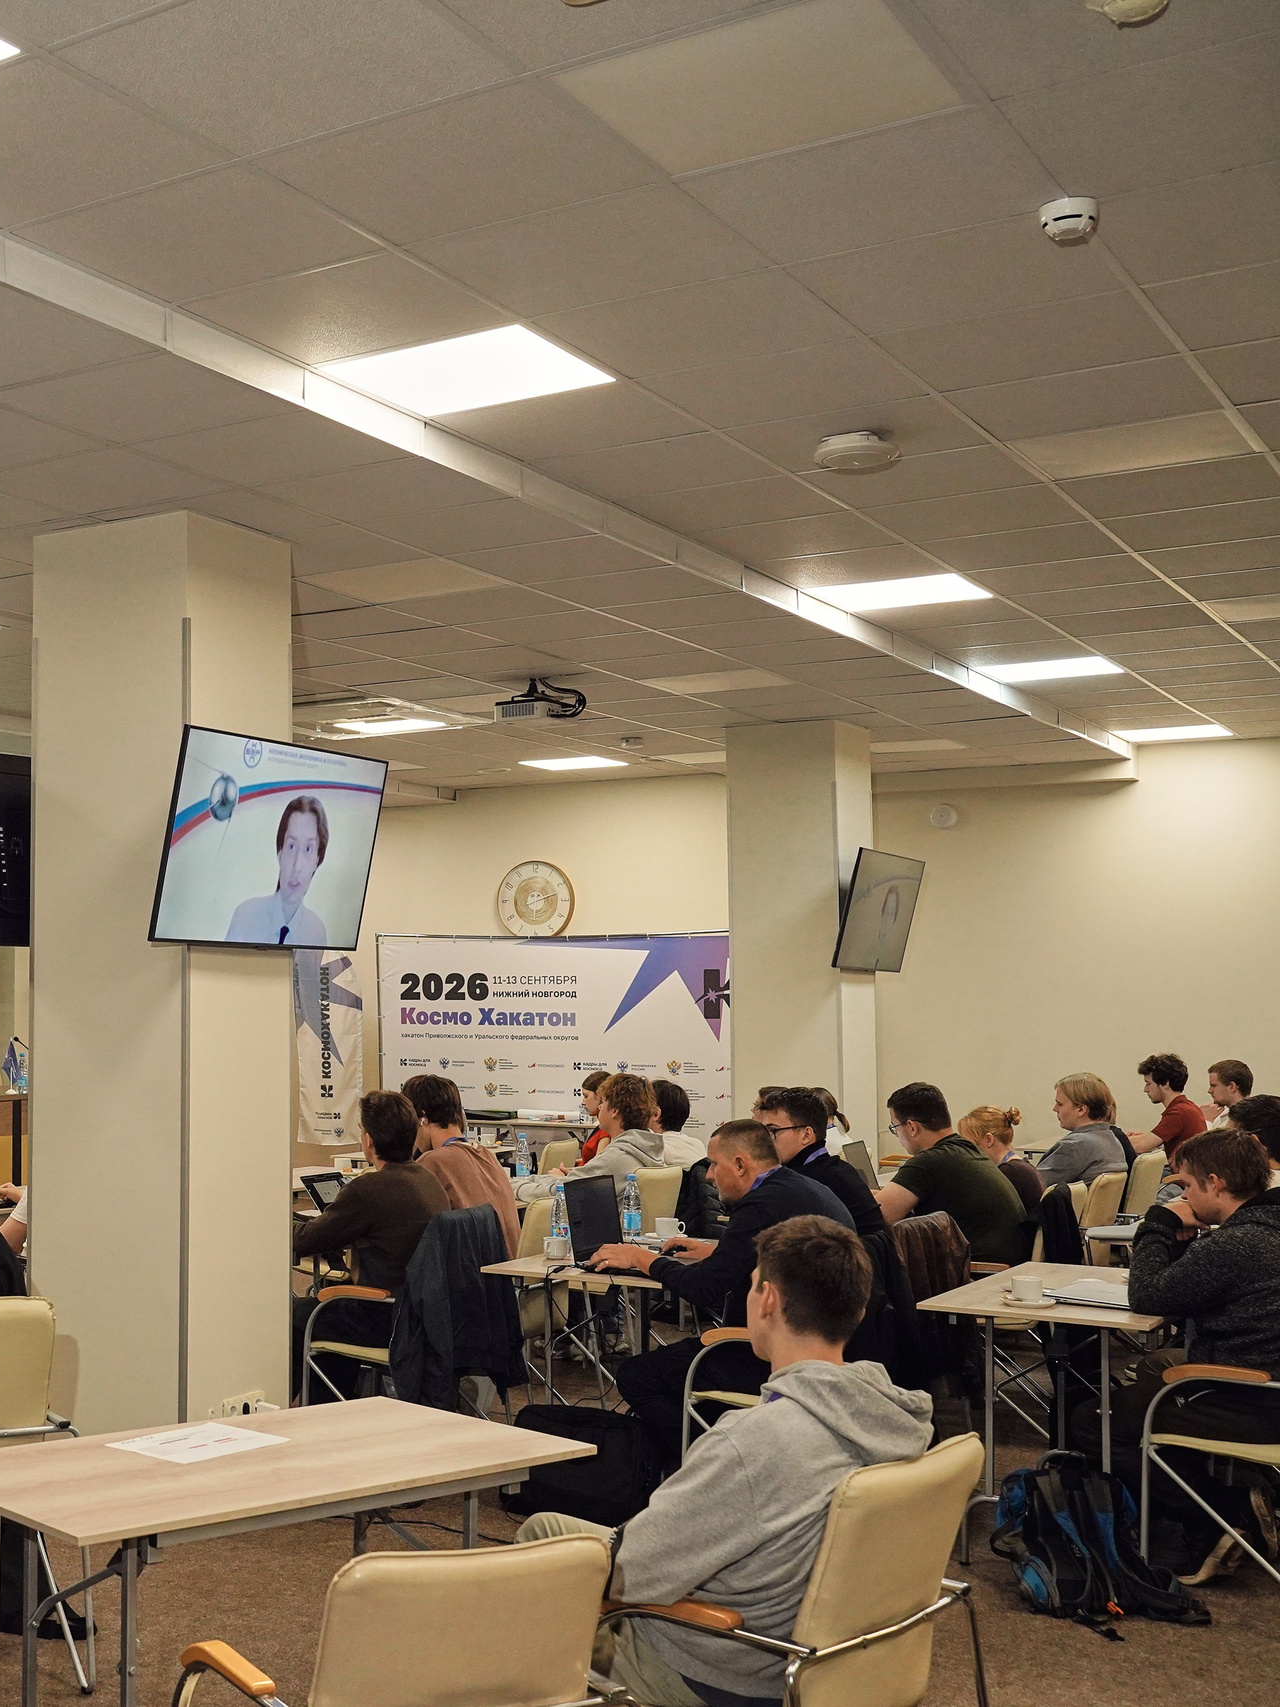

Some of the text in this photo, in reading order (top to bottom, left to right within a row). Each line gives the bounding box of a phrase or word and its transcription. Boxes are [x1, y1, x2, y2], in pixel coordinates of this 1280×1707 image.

[492, 975, 577, 985] 11-13 СЕНТЯБРЯ
[400, 972, 489, 1001] 2026
[492, 989, 577, 999] НИЖНИЙ НОВГОРОД
[400, 1007, 577, 1026] Космо Хакатон
[474, 1033, 509, 1041] Уральского
